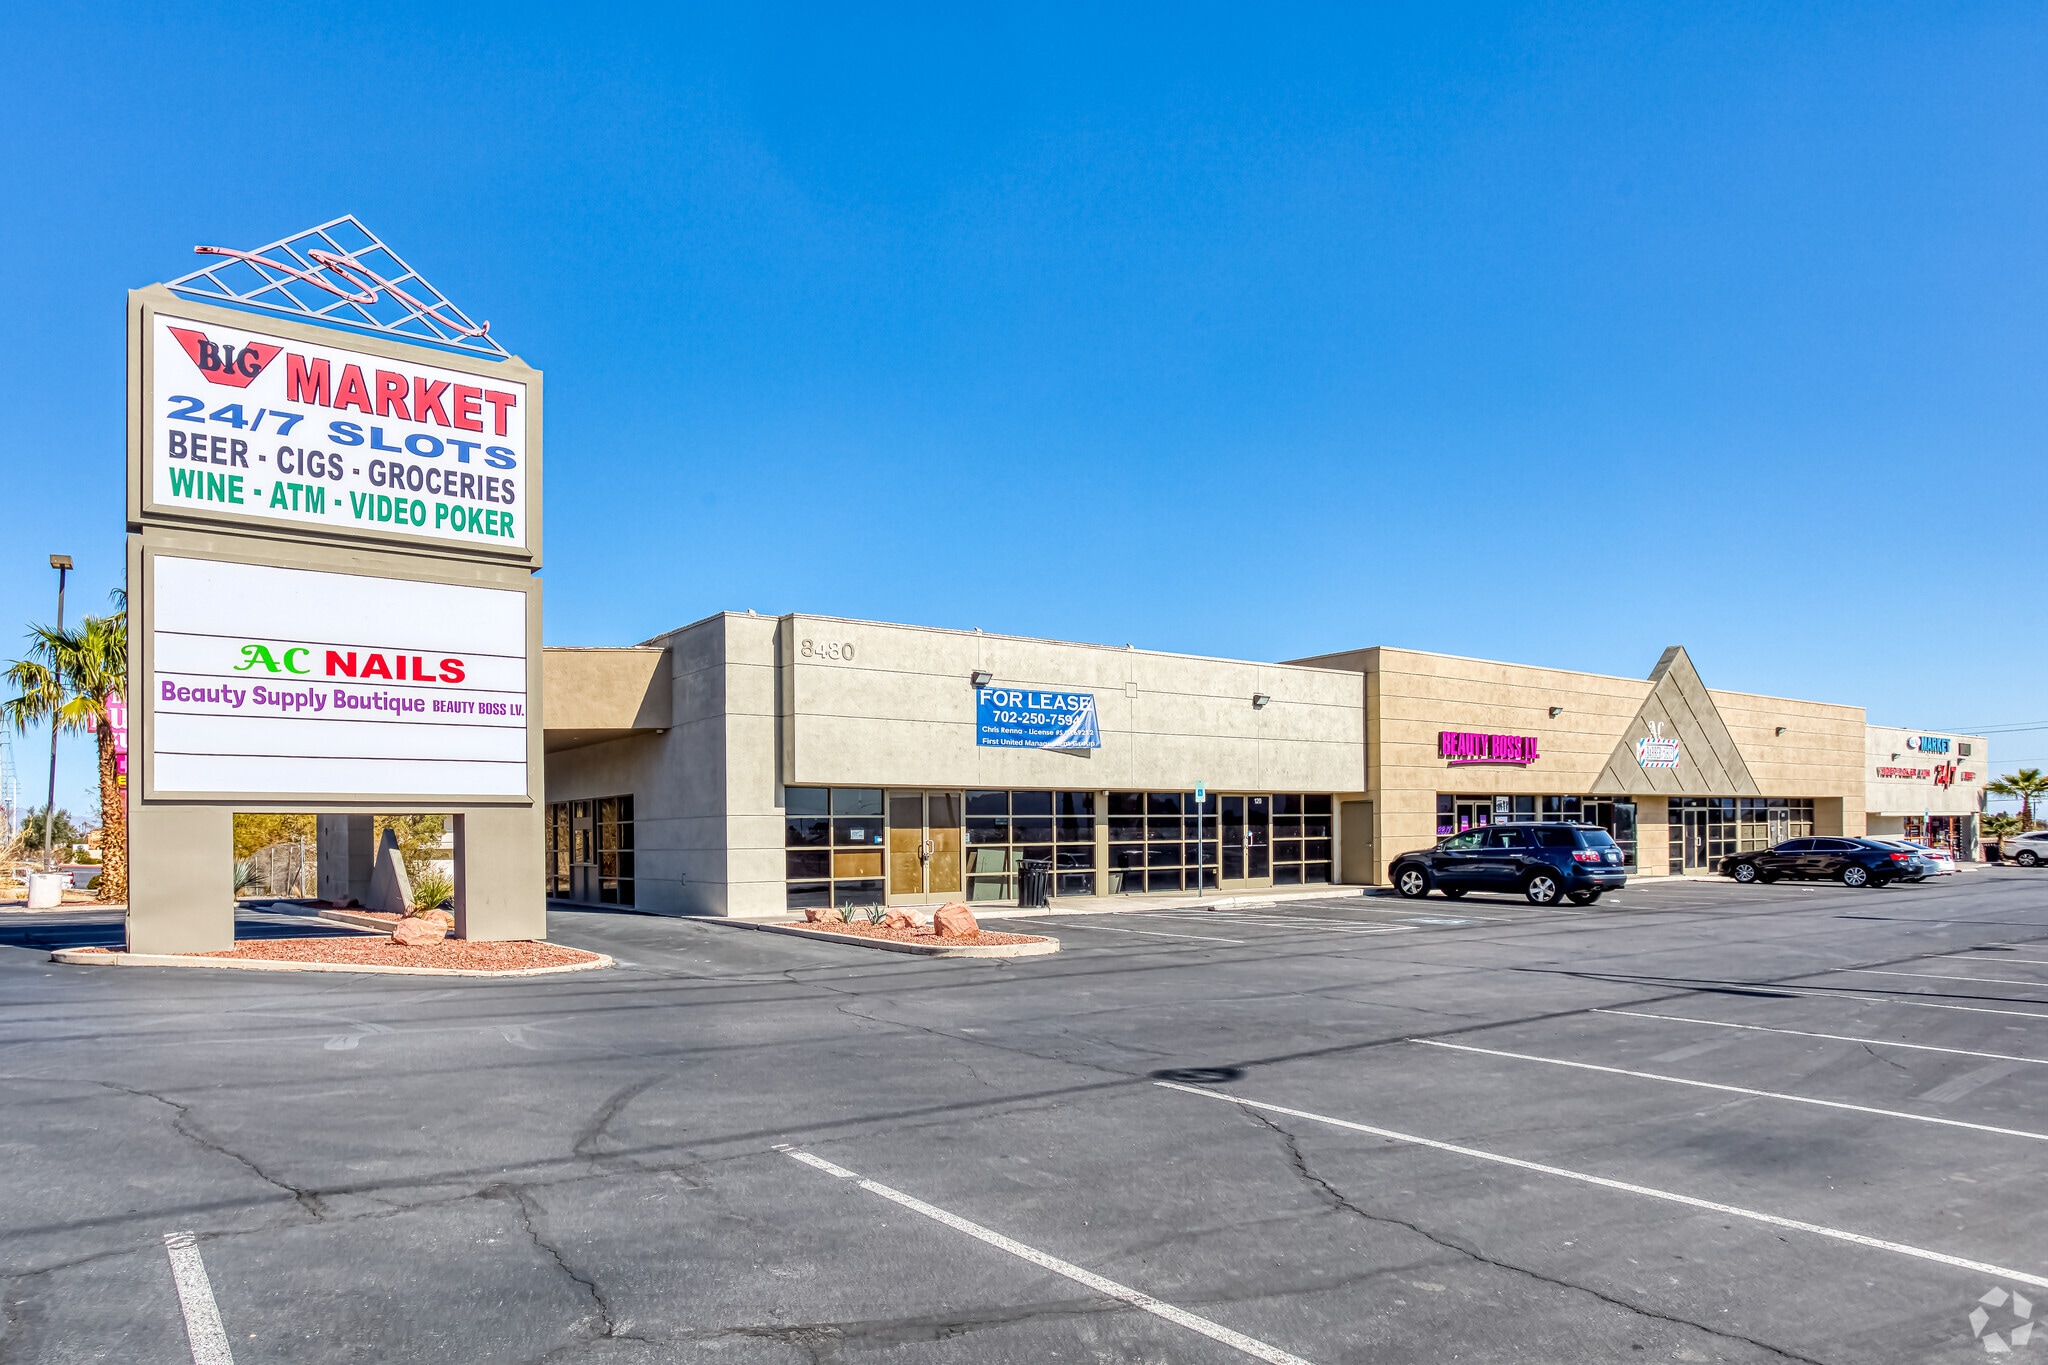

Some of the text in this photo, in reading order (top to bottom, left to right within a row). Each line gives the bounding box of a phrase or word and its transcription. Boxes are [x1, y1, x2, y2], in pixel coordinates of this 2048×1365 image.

[198, 339, 517, 437] BIG MARKET
[166, 395, 517, 470] 24/7 SLOTS
[168, 430, 249, 468] BEER
[276, 446, 344, 481] CIGS
[368, 459, 516, 505] GROCERIES
[169, 466, 245, 504] WINE
[269, 481, 325, 514] ATM
[349, 491, 427, 527] VIDEO
[435, 503, 515, 538] POKER
[233, 644, 466, 684] AC NAILS
[800, 638, 856, 661] 8480
[161, 680, 525, 717] Beauty Supply Boutique BEAUTY BOSS LV.
[980, 689, 1092, 711] FOR LEASE
[982, 725, 999, 733] Chris
[1029, 728, 1054, 736] License
[982, 737, 999, 745] First
[1001, 738, 1023, 746] United
[1442, 731, 1489, 757] BEAUTY
[1492, 734, 1523, 759] BOSS
[1920, 735, 1951, 753] MARKET
